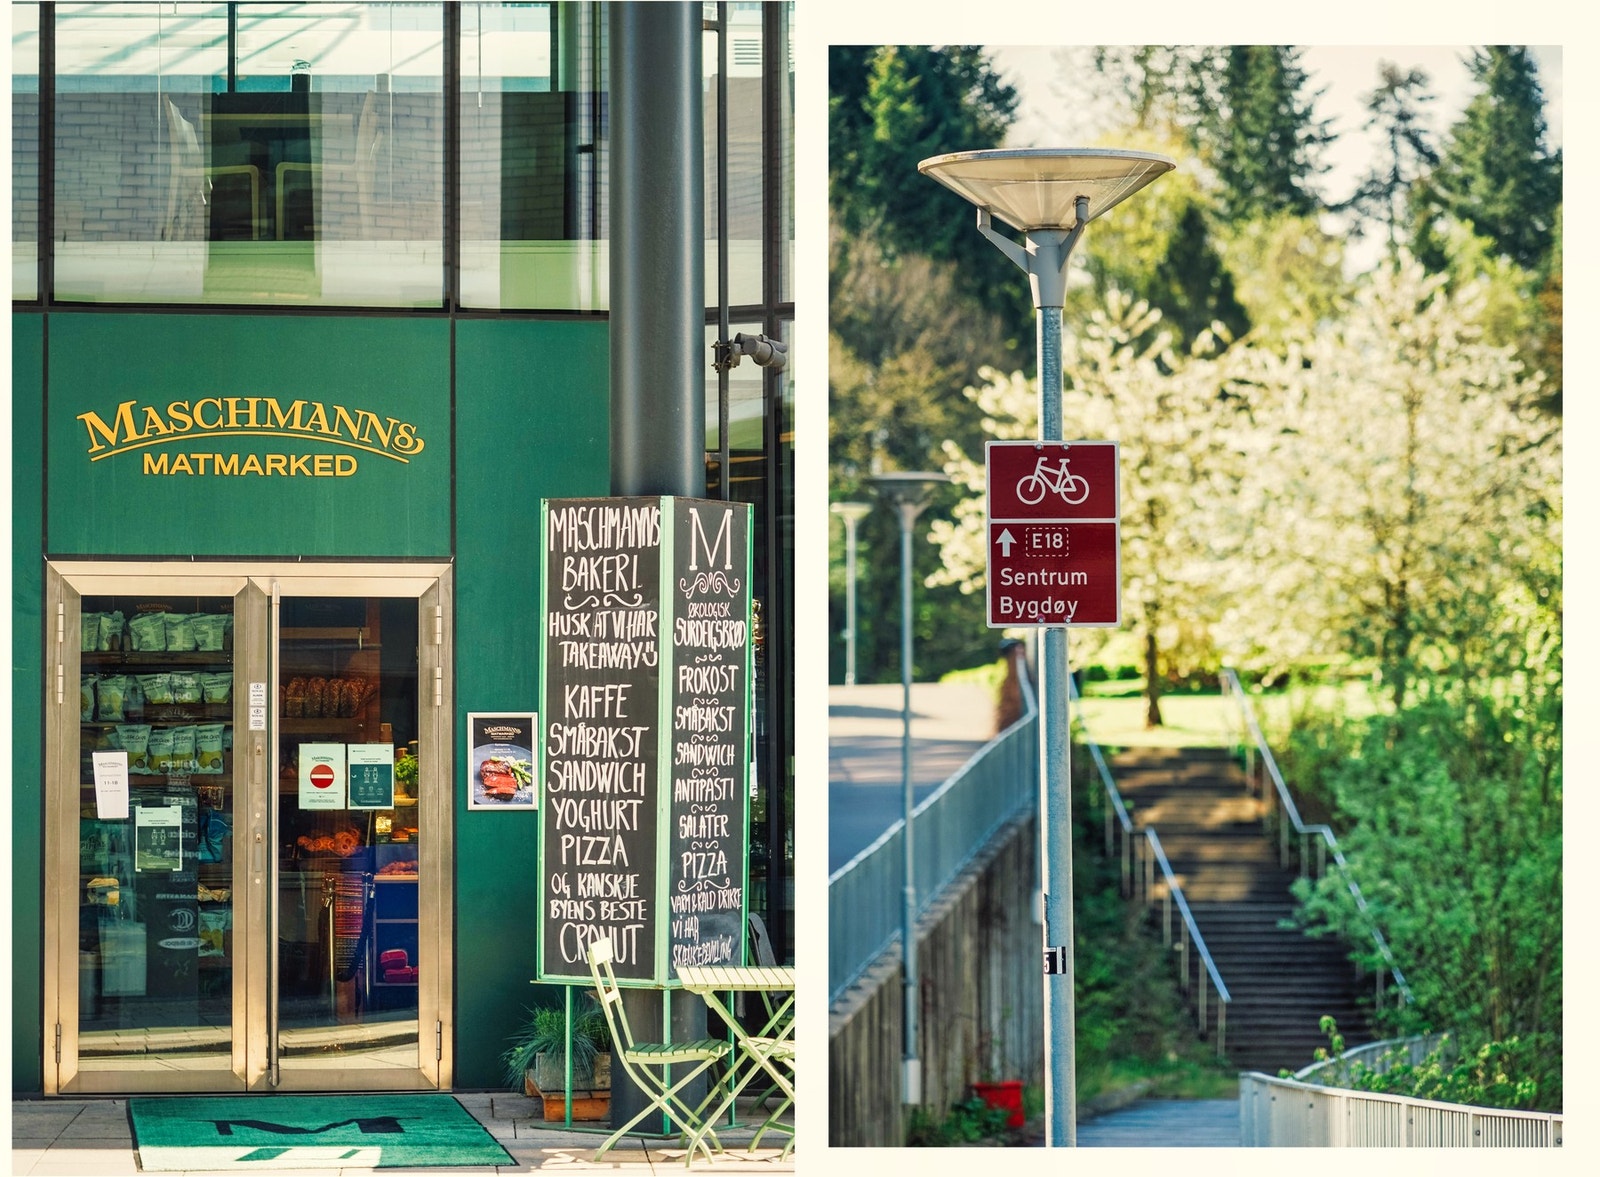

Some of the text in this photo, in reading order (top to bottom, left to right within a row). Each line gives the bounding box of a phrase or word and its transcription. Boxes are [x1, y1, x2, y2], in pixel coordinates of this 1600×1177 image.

[142, 453, 359, 477] MATMARKED
[550, 506, 661, 552] MASCHMANNS
[689, 507, 733, 571] M
[1032, 533, 1063, 549] E18
[1000, 567, 1088, 586] Sentrum
[688, 602, 731, 620] ØKOLOGISK
[1000, 596, 1078, 619] Bygdøy
[550, 610, 658, 642] HUSK AT VI HAR
[679, 664, 739, 695] FROKOST
[564, 684, 633, 720] KAFFE
[674, 704, 736, 733] SMÅBAKST
[548, 722, 649, 759] SMÅBAKST
[674, 742, 735, 767] SANDWICH
[548, 760, 646, 796] SANDWICH
[674, 777, 734, 803] ANTIPASTI
[551, 797, 644, 833] YOGHURT
[679, 814, 730, 840] SALATER
[561, 834, 629, 867] PIZZA
[681, 850, 728, 879] PIZZA
[551, 873, 640, 901] OG KANSKJE
[550, 899, 647, 921] BYENS BESTE
